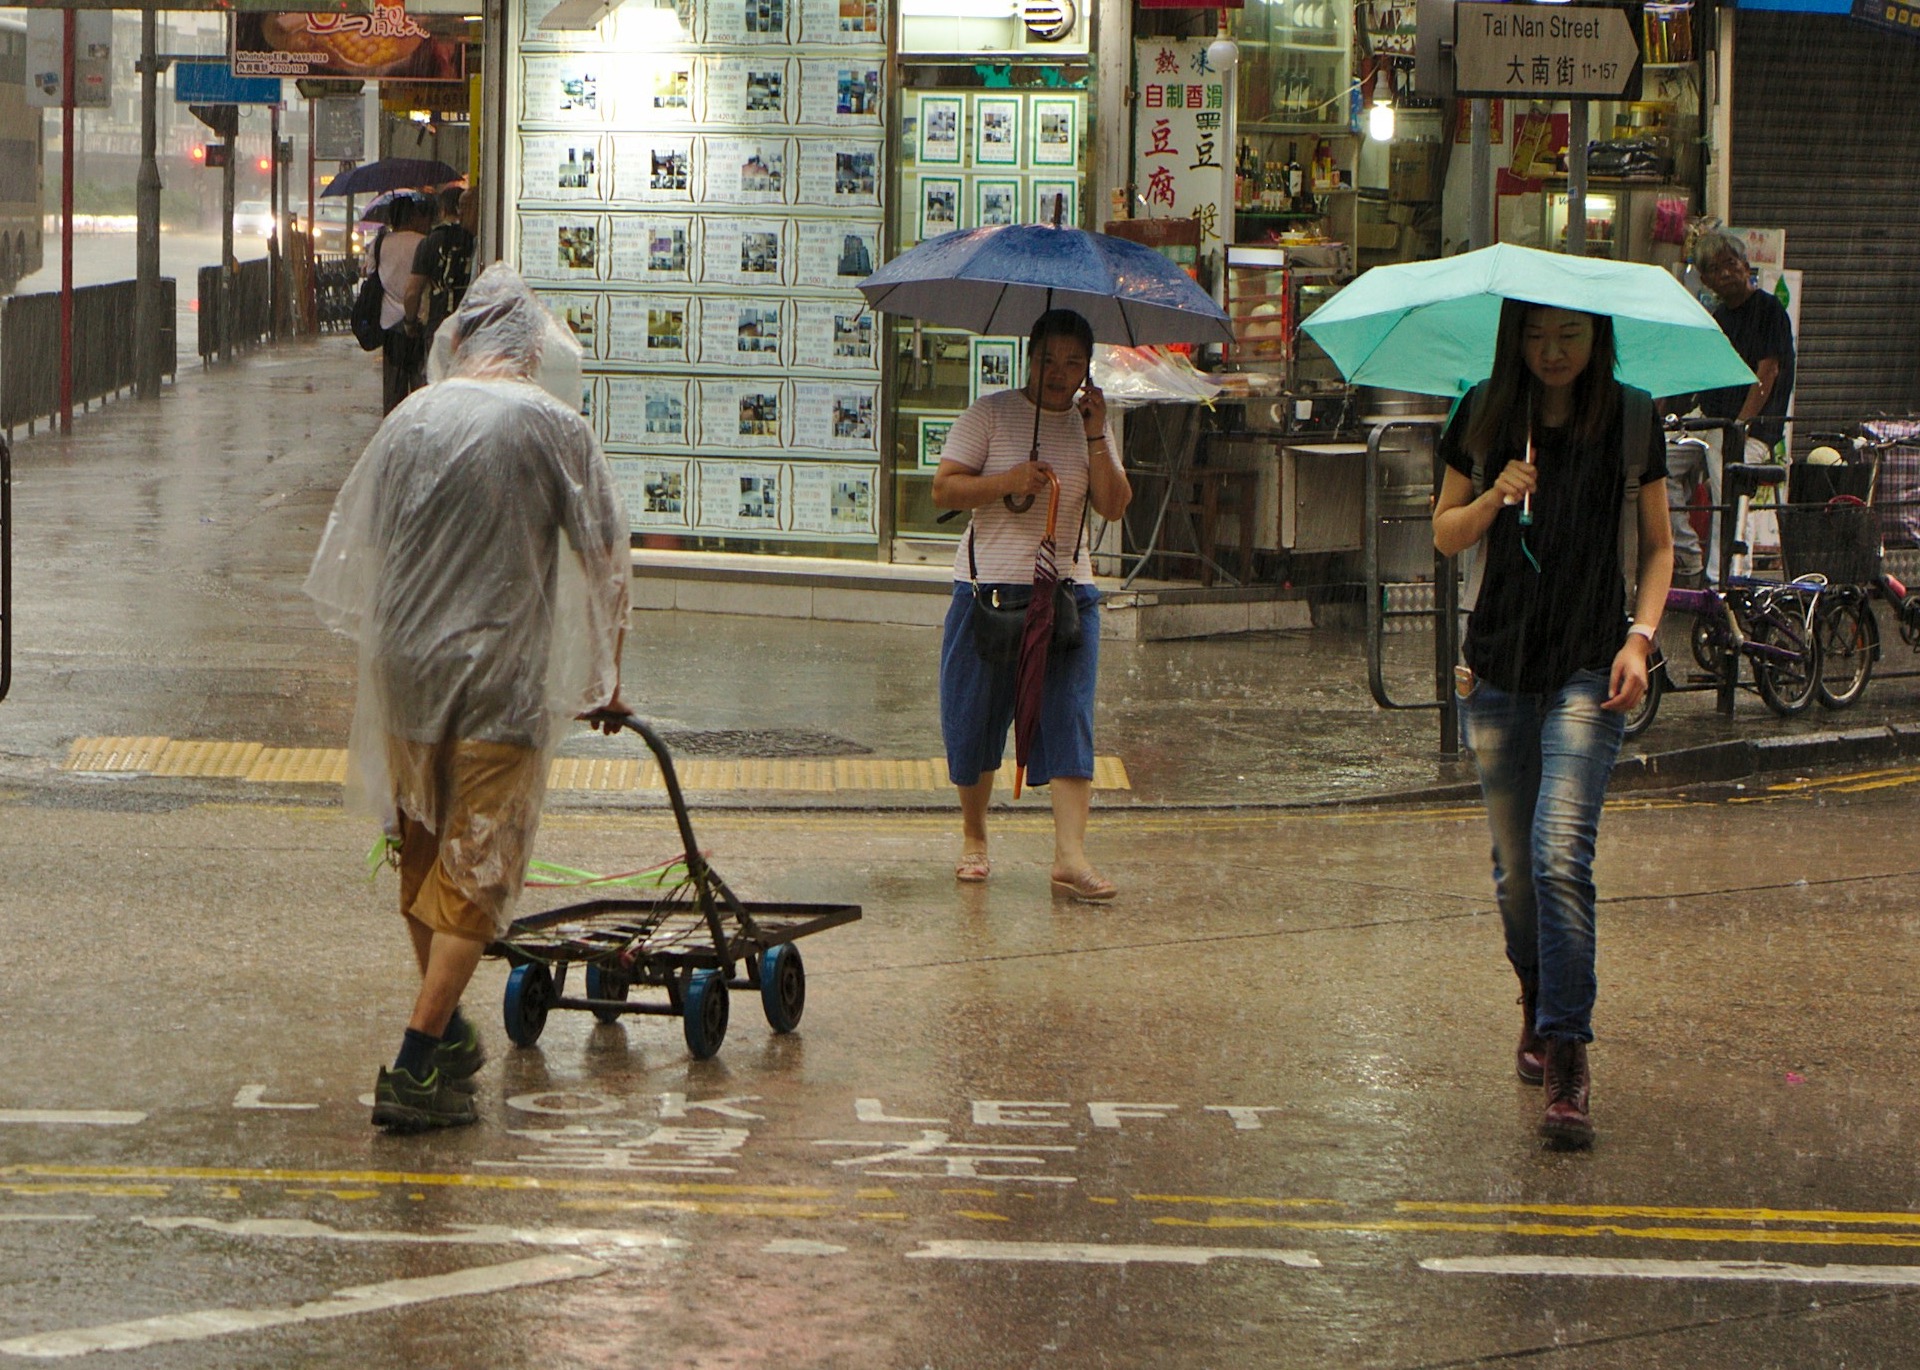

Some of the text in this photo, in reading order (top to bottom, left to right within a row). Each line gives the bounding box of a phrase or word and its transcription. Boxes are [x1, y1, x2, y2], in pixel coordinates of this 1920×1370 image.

[1482, 13, 1600, 39] Tai Nan Street
[1155, 47, 1180, 75] 熱
[1506, 54, 1575, 86] 大南街
[1145, 83, 1223, 110] 自制香滑
[1144, 118, 1178, 219] 豆腐
[234, 1084, 1284, 1130] LOK LEFT
